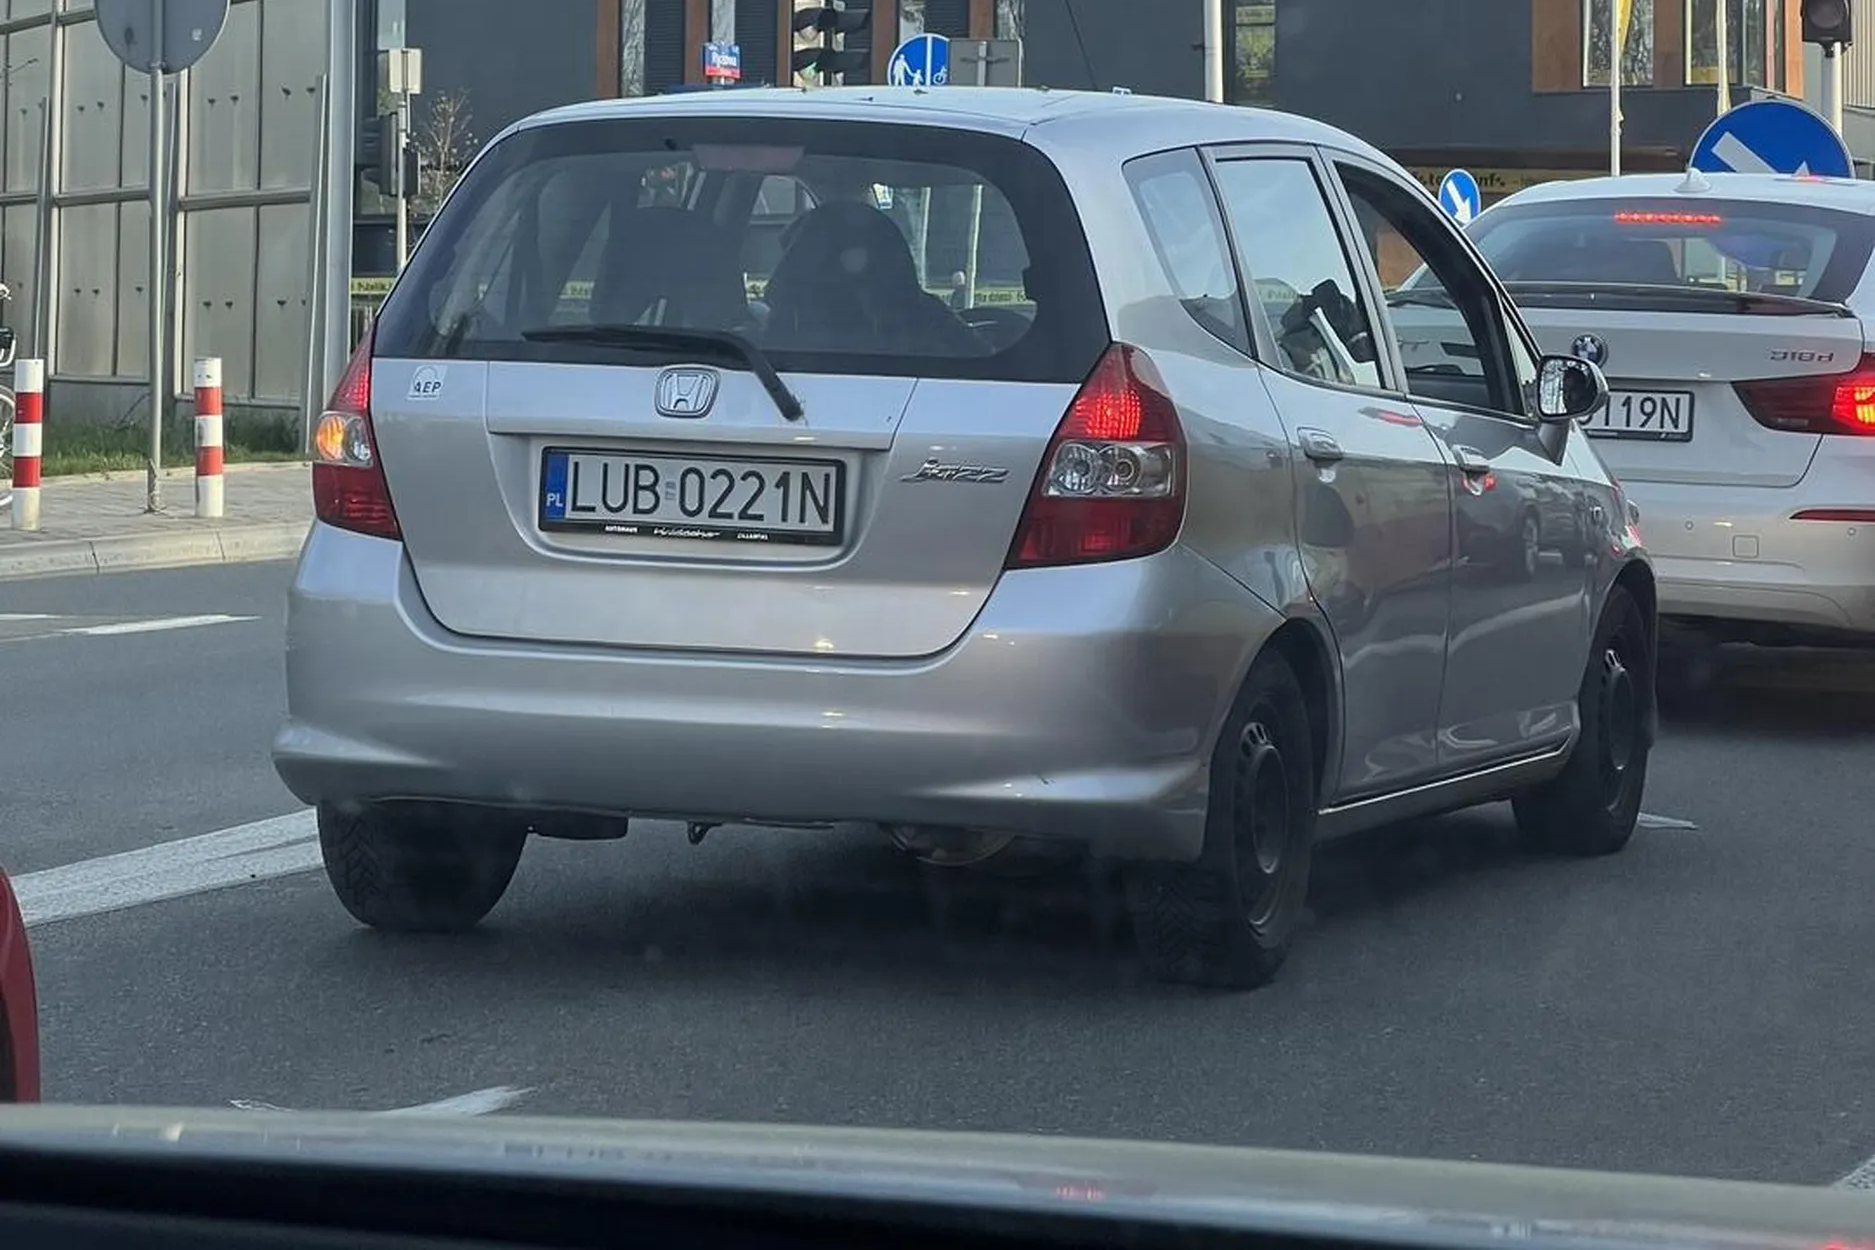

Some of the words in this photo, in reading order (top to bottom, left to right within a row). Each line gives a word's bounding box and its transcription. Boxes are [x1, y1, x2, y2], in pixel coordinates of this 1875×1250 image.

[1578, 394, 1681, 430] 119N
[546, 492, 564, 507] PL
[571, 461, 660, 514] LUB
[679, 466, 831, 525] 0221N
